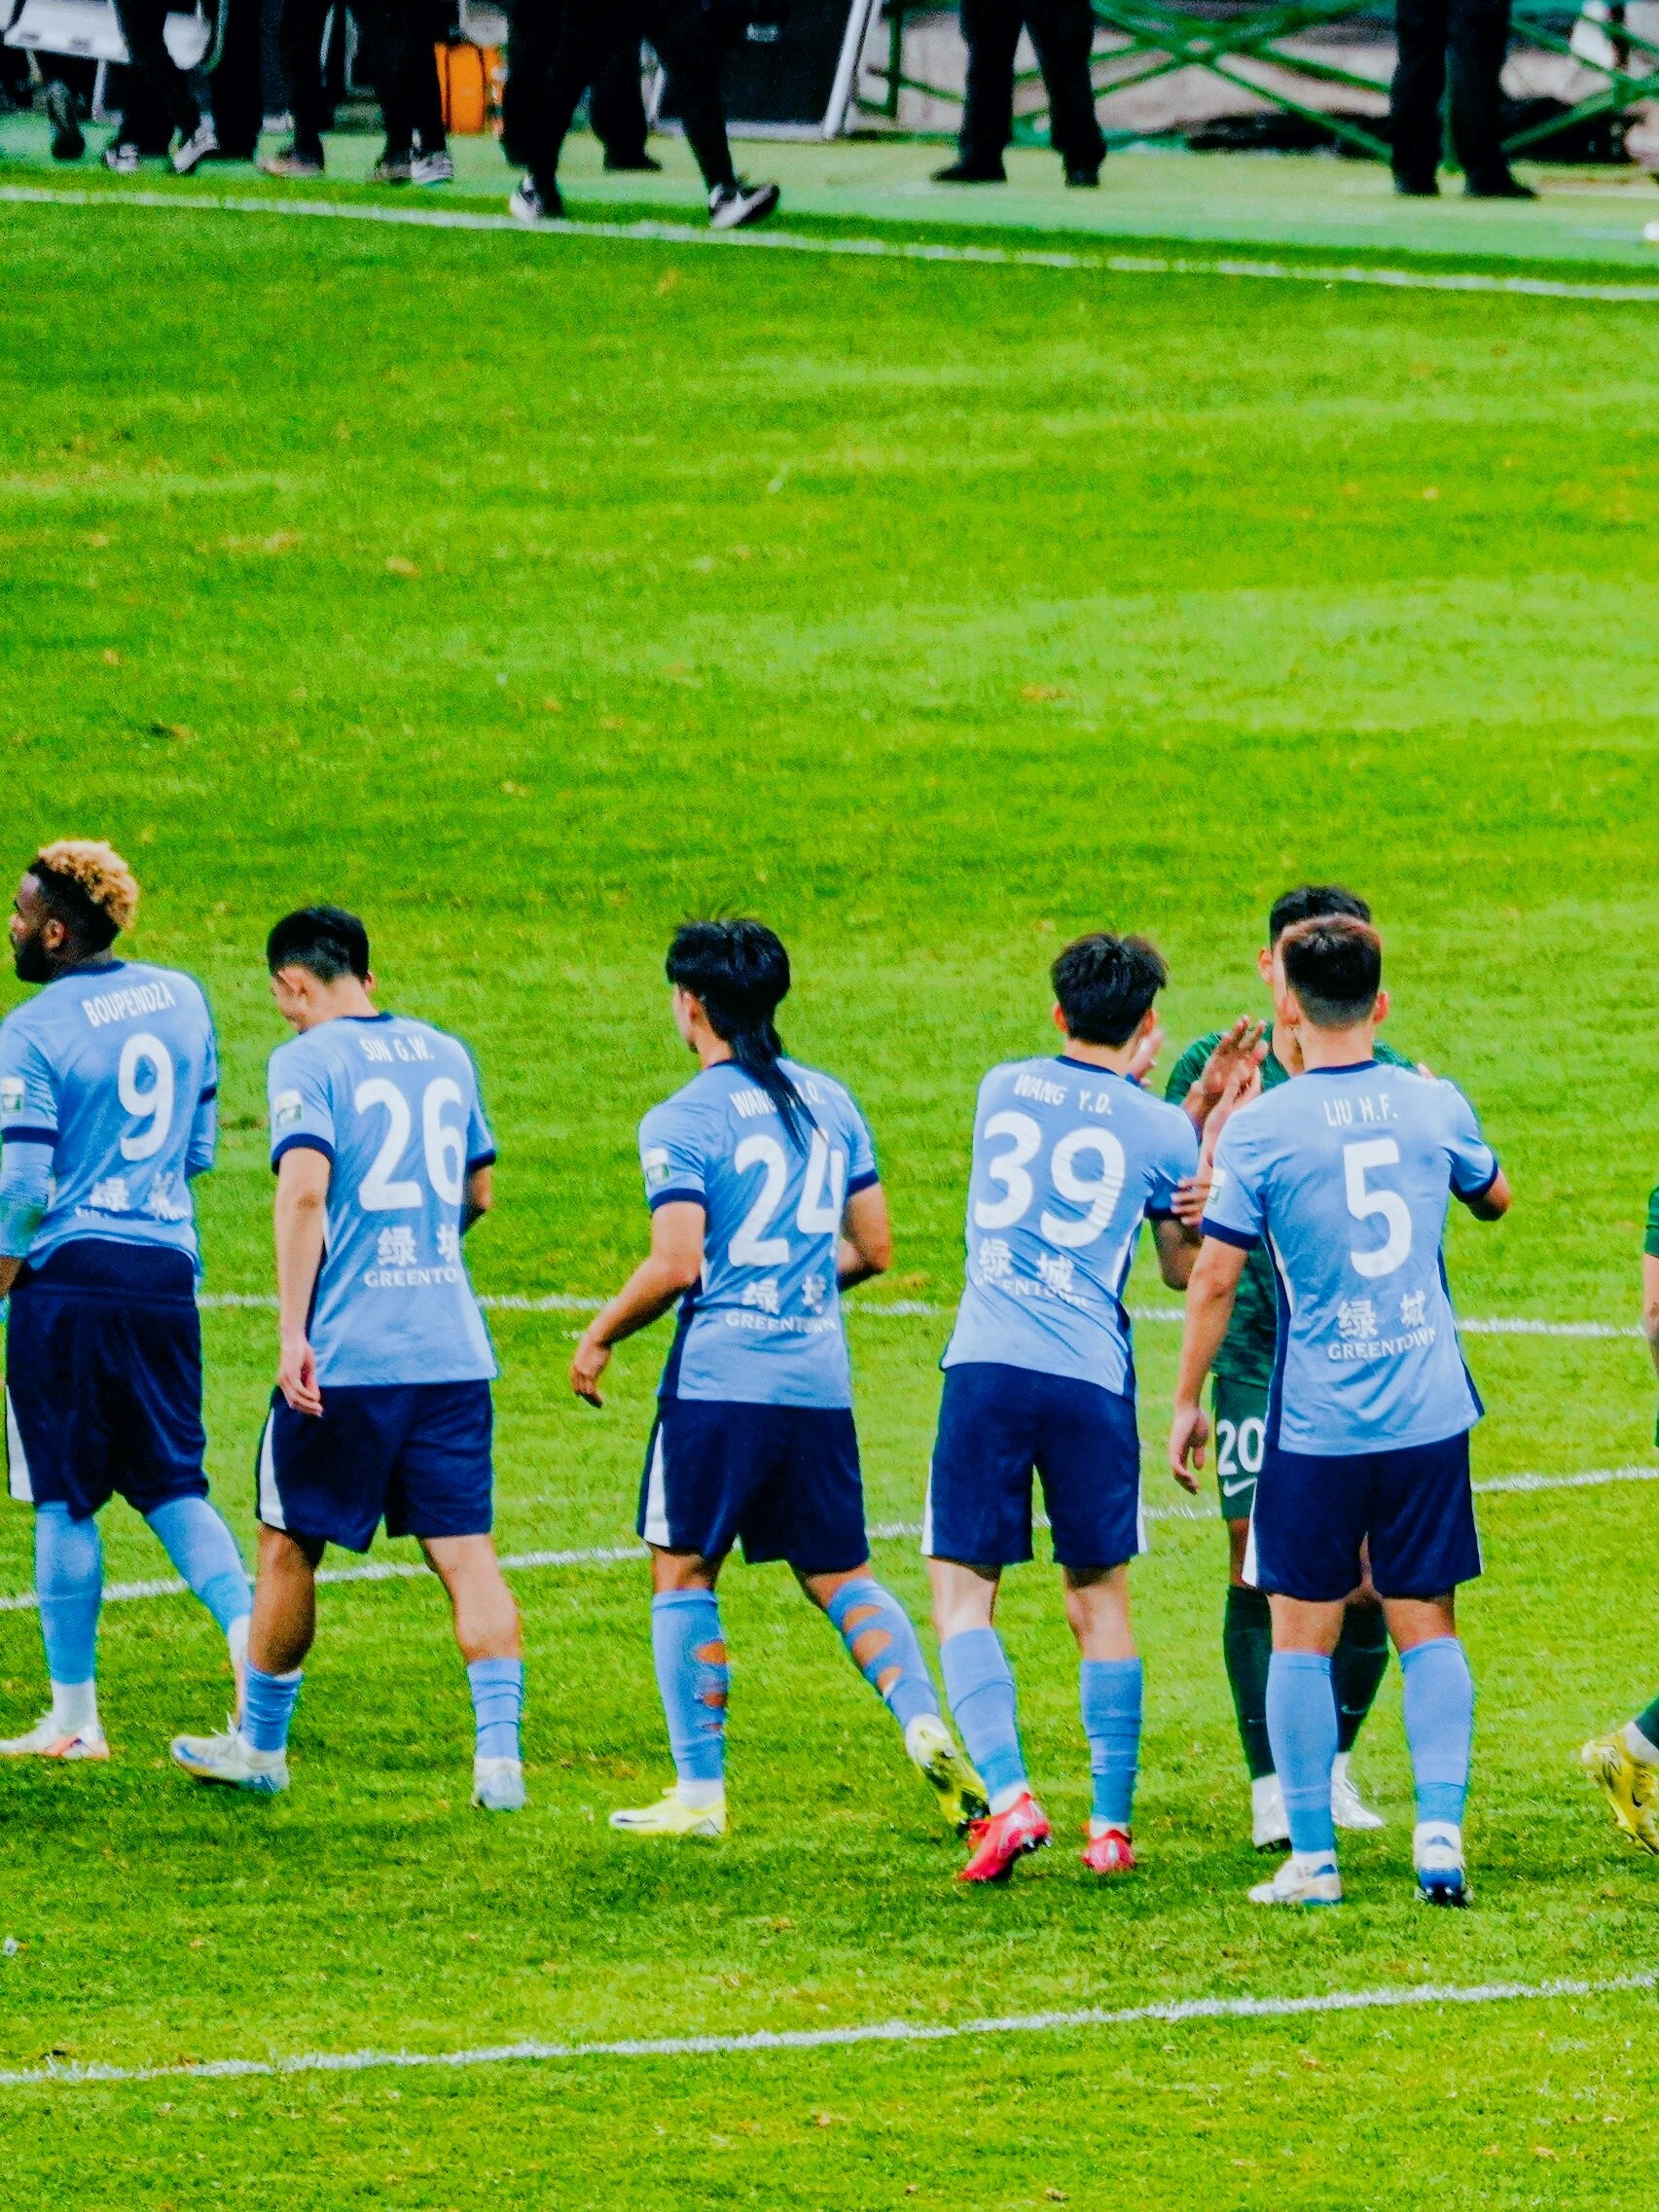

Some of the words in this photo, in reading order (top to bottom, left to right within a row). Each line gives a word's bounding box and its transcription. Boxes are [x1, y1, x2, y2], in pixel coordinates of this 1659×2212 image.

[82, 981, 175, 1027] BOUPENDZA
[118, 1033, 174, 1161] 9
[1013, 1073, 1067, 1106] WANG
[1078, 1089, 1113, 1116] Y.D.
[1323, 1098, 1352, 1127] LIU
[1358, 1093, 1399, 1124] H.F.
[354, 1077, 463, 1211] 26
[974, 1110, 1126, 1249] 39
[728, 1128, 844, 1267] 24
[1342, 1138, 1412, 1278] 5
[364, 1267, 461, 1288] GREENTO
[1216, 1417, 1266, 1477] 20
